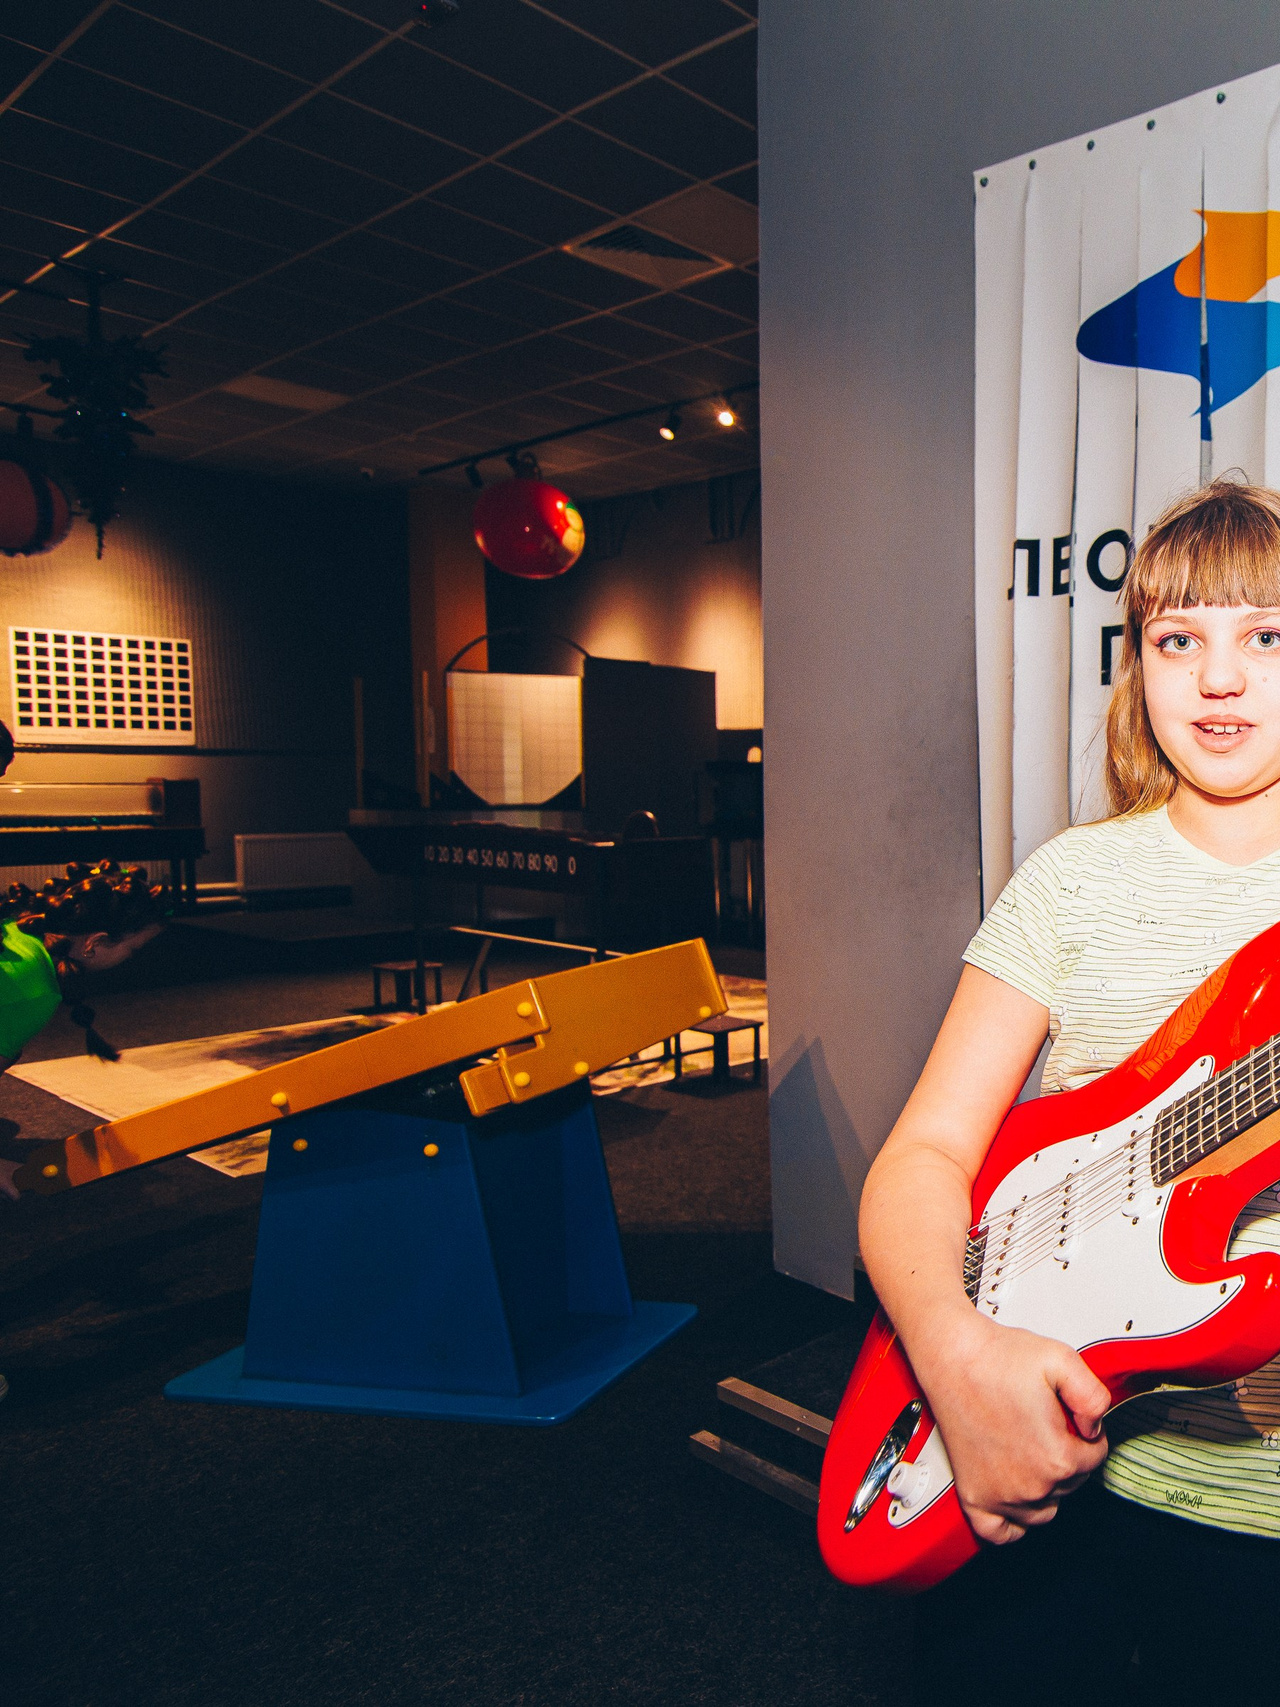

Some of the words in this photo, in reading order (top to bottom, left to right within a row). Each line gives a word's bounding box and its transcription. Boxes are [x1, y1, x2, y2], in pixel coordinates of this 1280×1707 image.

[467, 848, 479, 865] 40
[481, 848, 494, 867] 50
[496, 850, 509, 868] 60
[512, 851, 525, 870] 70
[528, 852, 541, 871] 80
[544, 854, 558, 873] 90
[568, 856, 577, 875] 0
